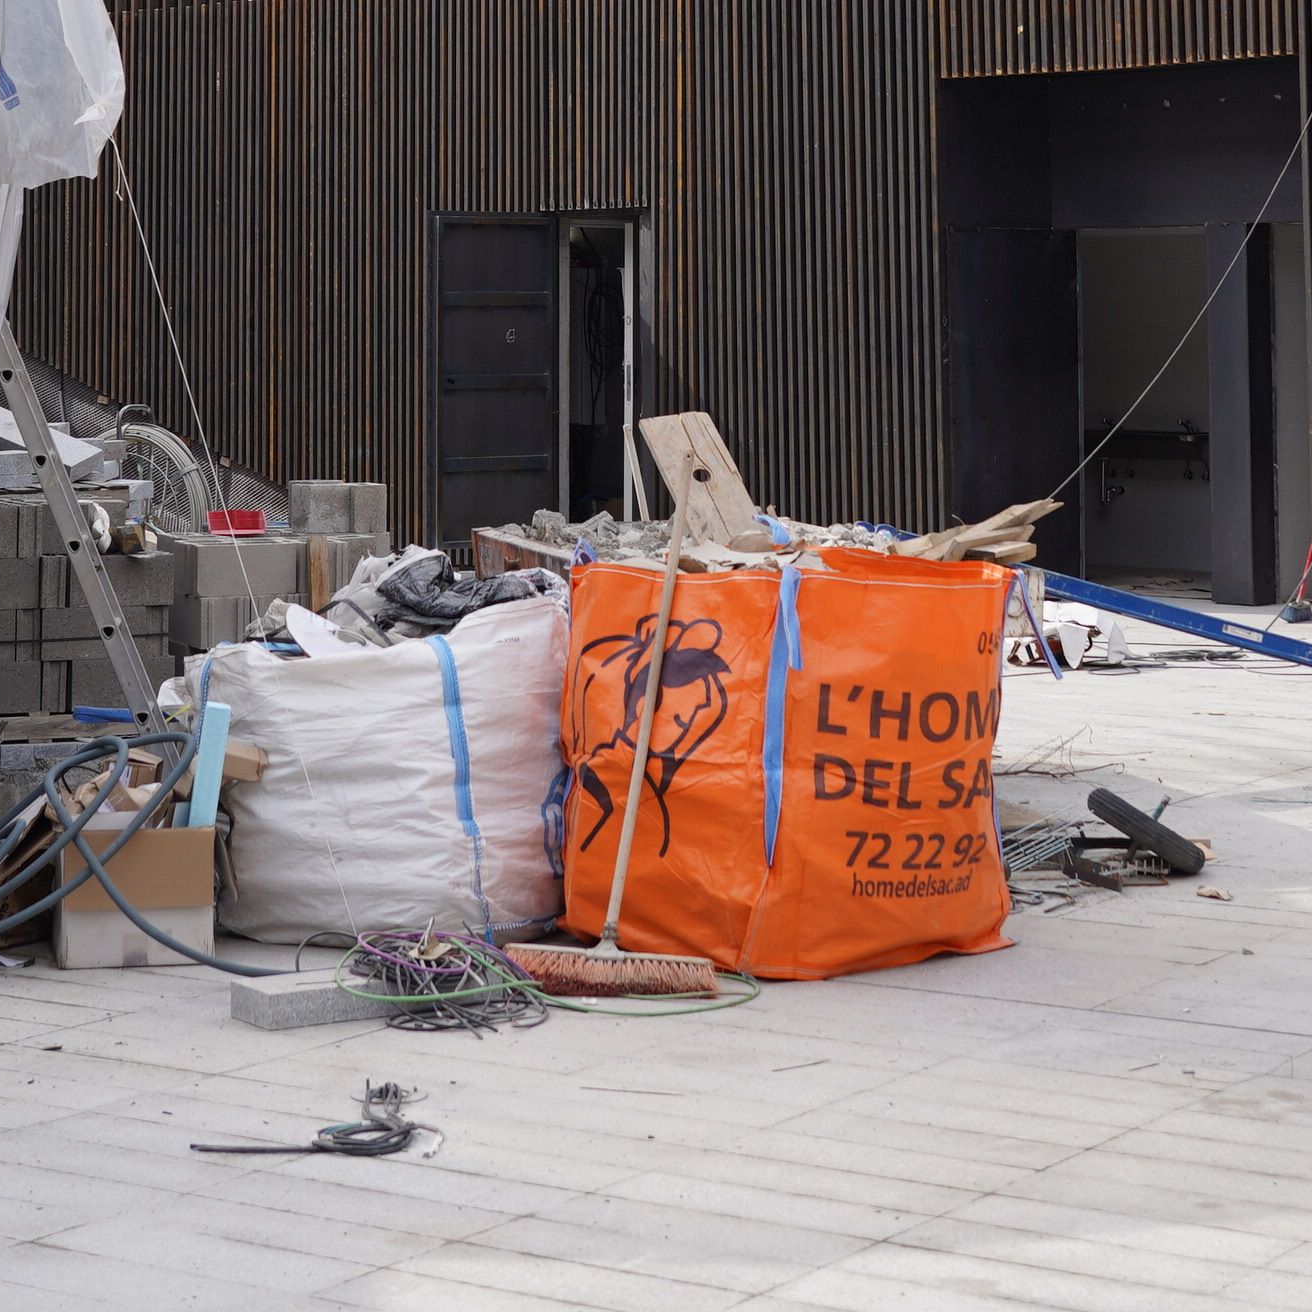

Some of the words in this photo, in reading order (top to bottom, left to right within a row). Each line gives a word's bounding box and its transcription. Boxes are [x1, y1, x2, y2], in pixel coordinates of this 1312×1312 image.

[814, 753, 922, 810] DEL
[846, 831, 892, 870] 72
[902, 833, 946, 870] 22
[952, 831, 987, 868] 92
[851, 869, 973, 898] homedelsac.ad
